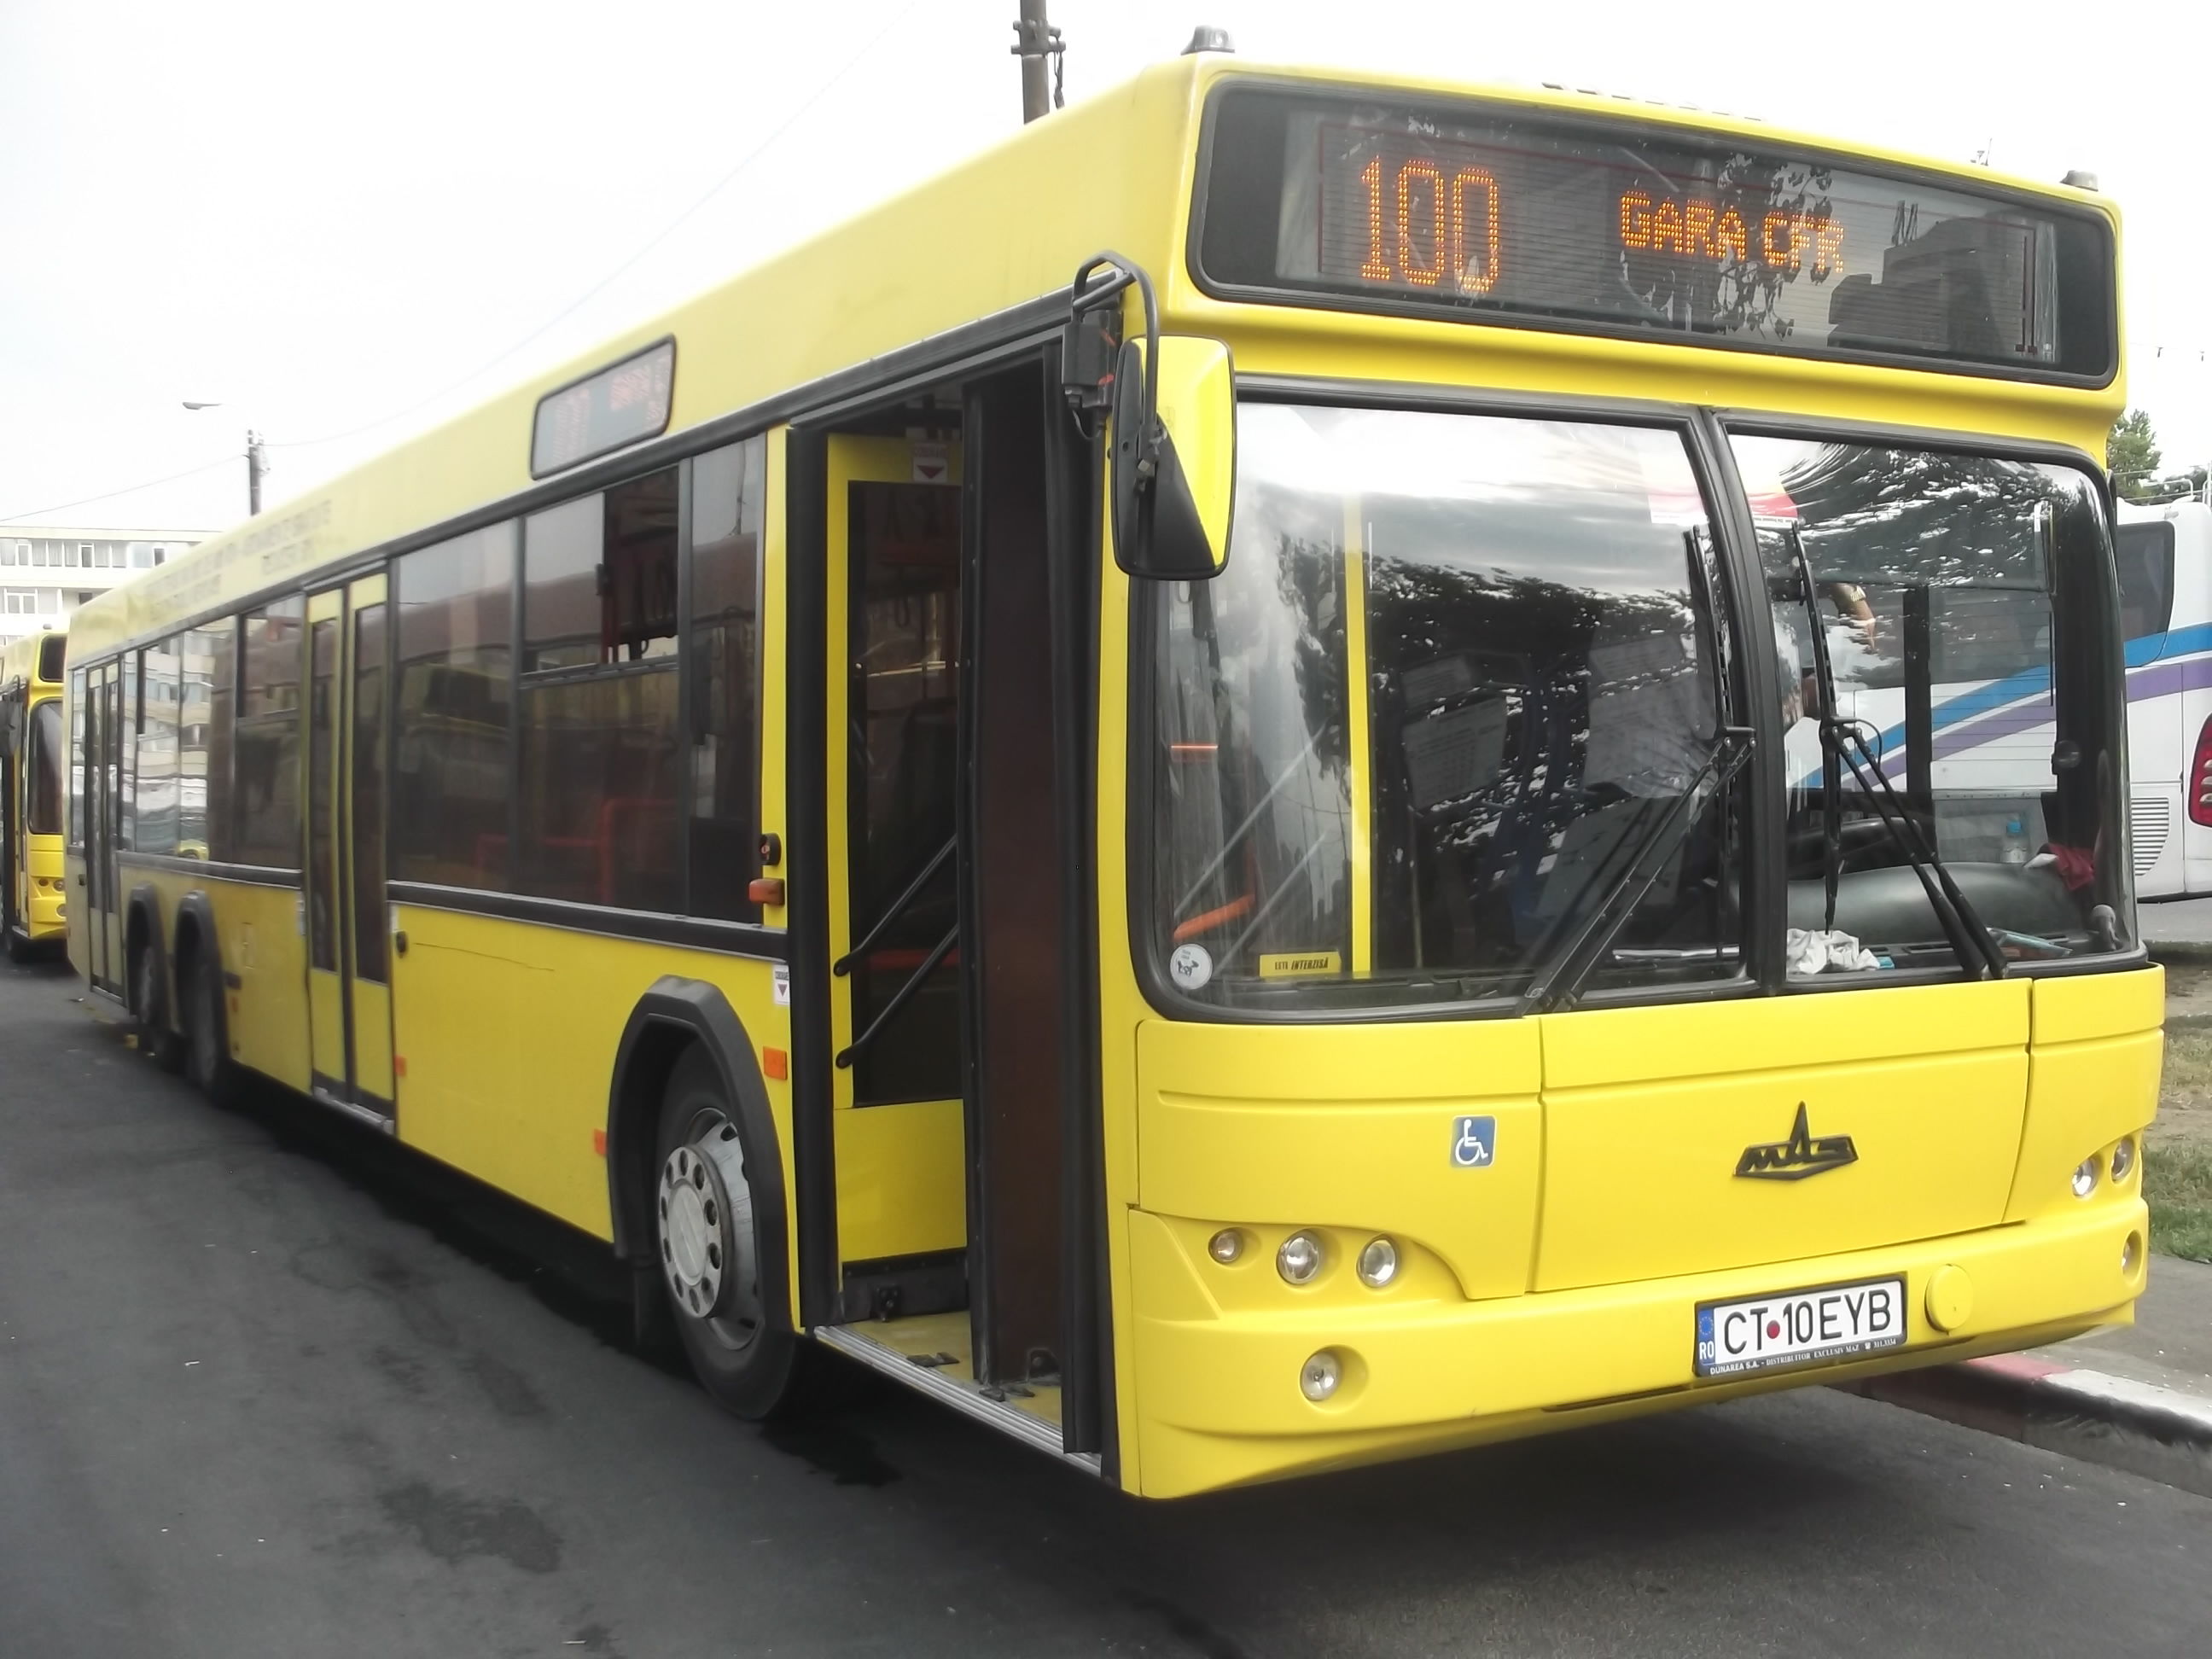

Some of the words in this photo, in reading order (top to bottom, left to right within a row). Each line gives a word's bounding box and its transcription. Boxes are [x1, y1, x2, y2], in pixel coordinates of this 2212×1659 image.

[1360, 155, 1499, 291] 100
[1621, 190, 1746, 261] GARA
[1764, 211, 1844, 272] CFR
[1699, 1341, 1714, 1359] RO
[1710, 1363, 1744, 1375] DUNAREA
